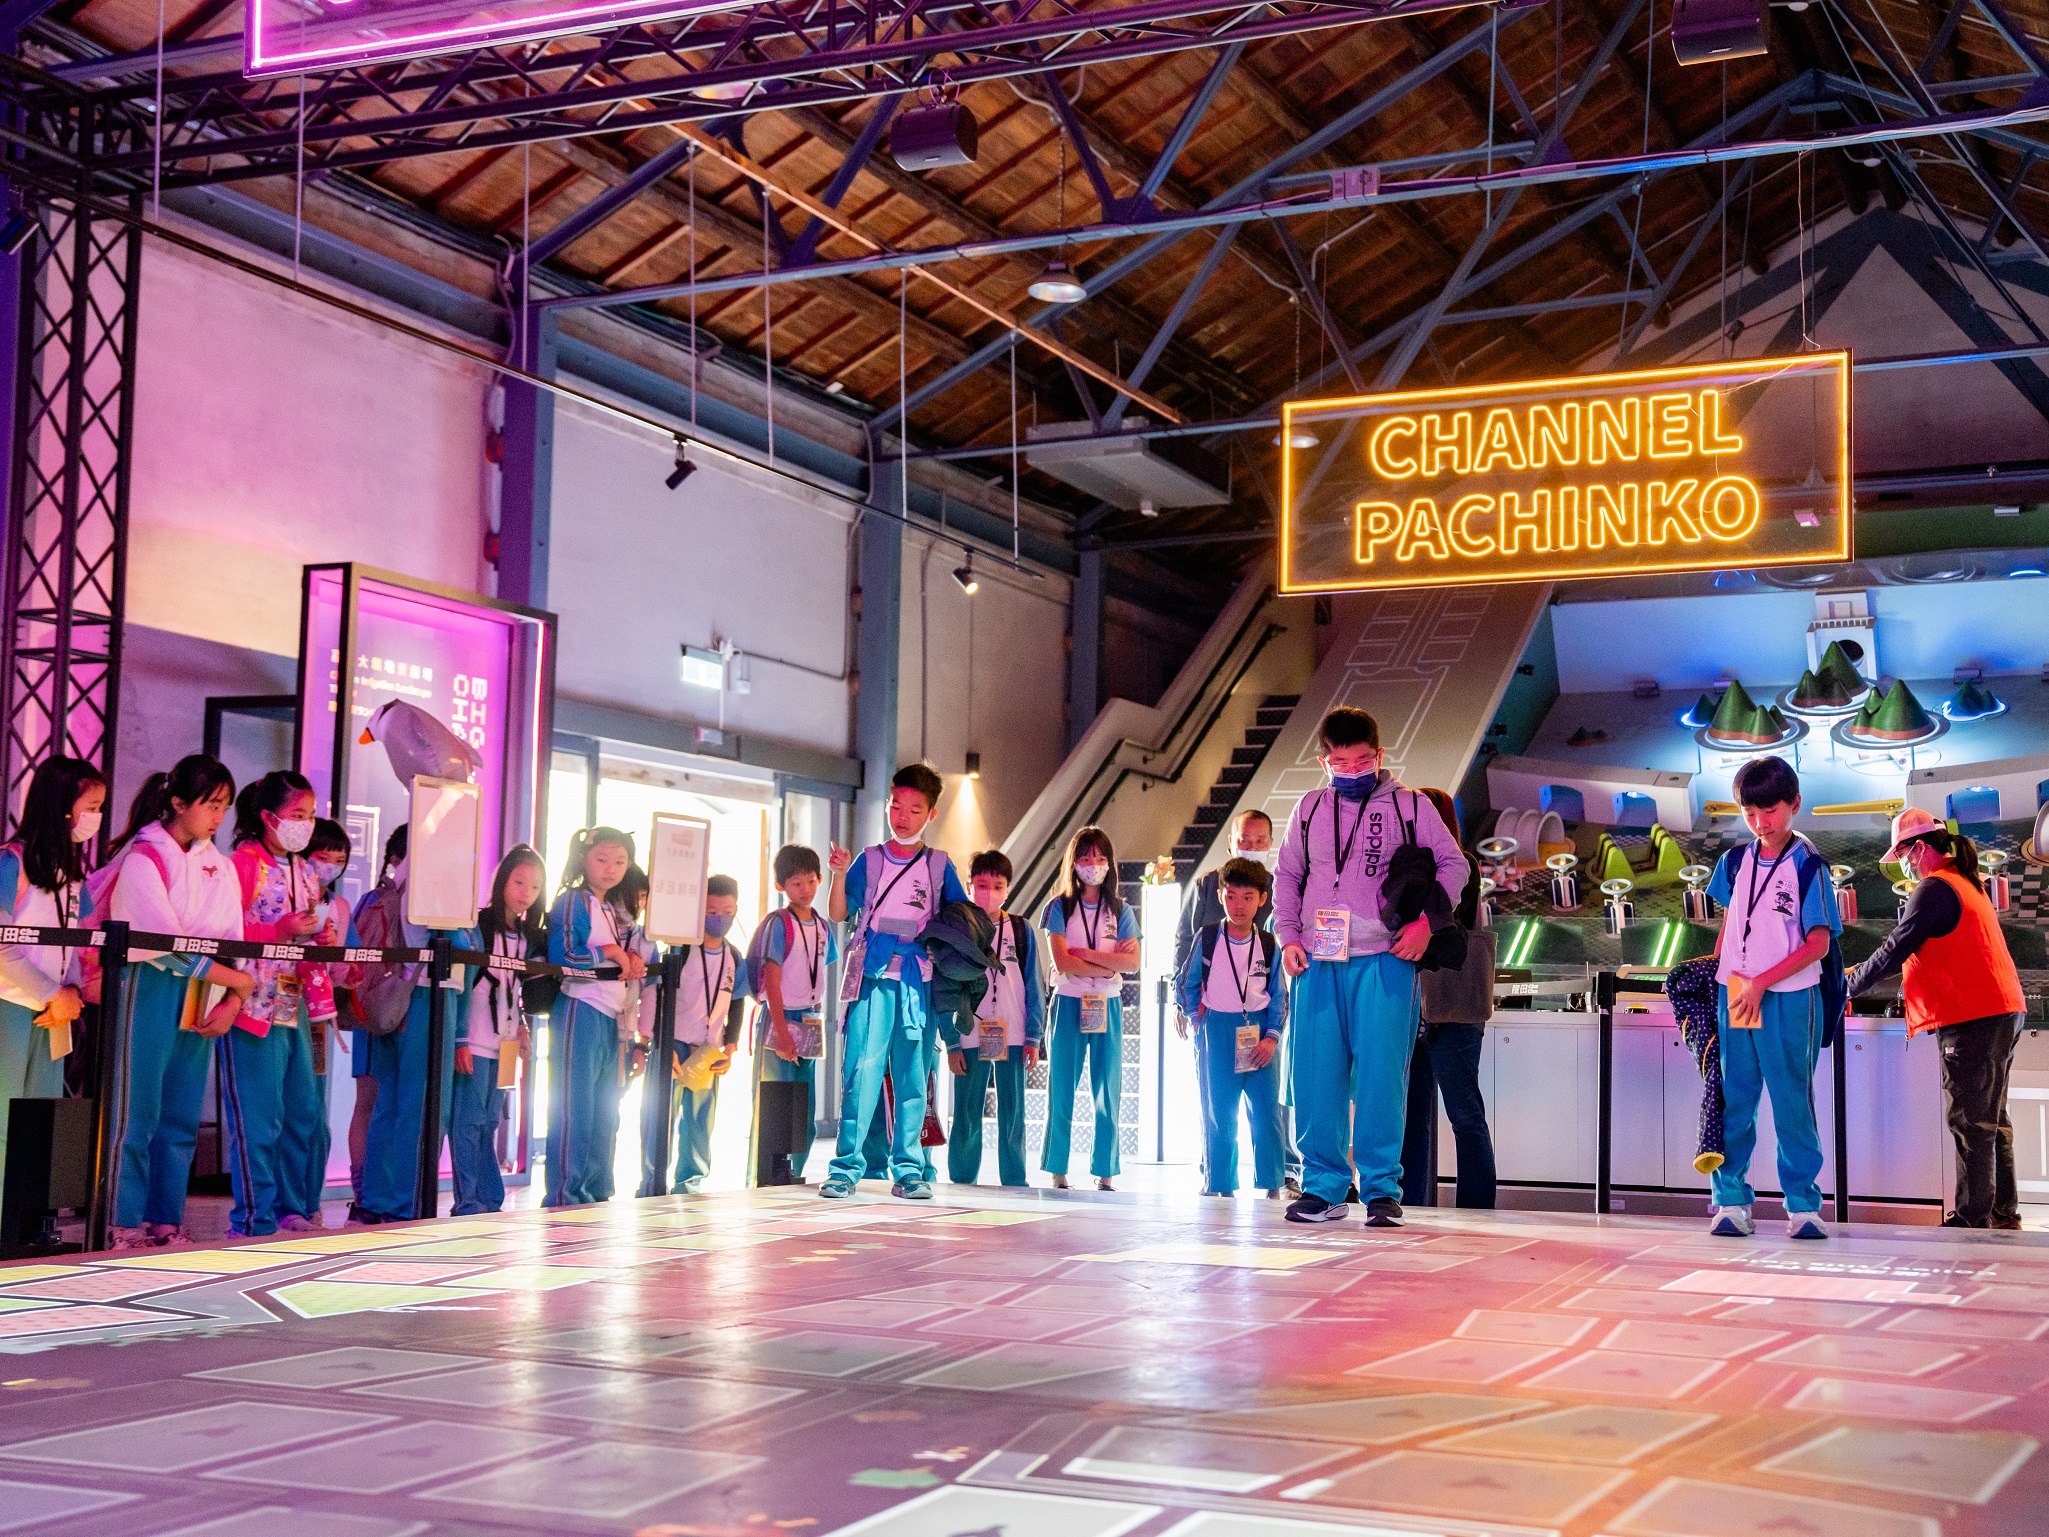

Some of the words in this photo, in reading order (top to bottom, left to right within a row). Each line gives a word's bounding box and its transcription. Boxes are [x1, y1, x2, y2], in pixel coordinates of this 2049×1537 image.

[1370, 389, 1743, 479] CHANNEL
[1353, 476, 1760, 564] PACHINKO
[1364, 812, 1383, 877] adidas
[0, 927, 19, 943] 田
